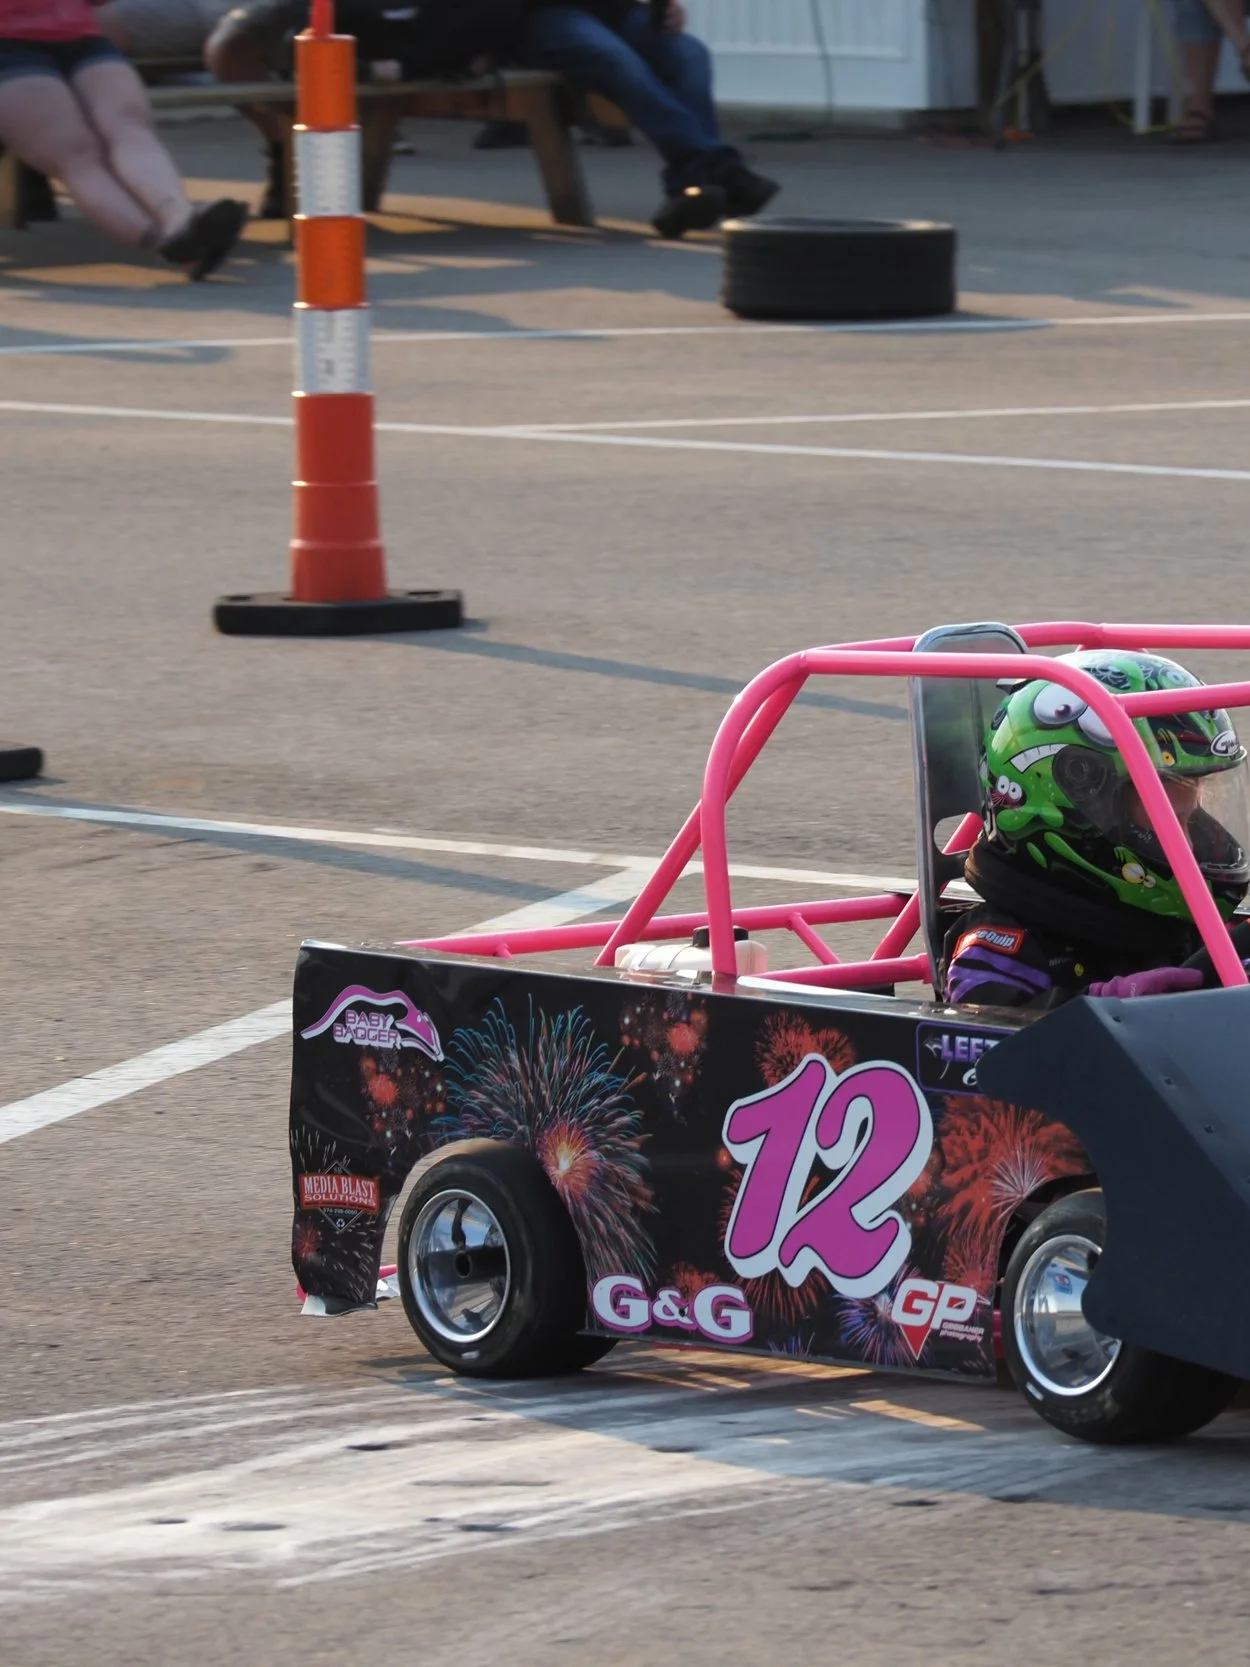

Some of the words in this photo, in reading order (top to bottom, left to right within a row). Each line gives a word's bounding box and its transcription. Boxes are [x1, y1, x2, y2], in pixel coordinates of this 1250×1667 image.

[966, 929, 1015, 949] eQuip
[345, 1010, 394, 1031] BABY
[333, 1023, 401, 1050] BADGER
[303, 1176, 339, 1194] MEDIA
[341, 1177, 375, 1199] BLAST
[722, 1052, 933, 1299] 12
[304, 1193, 376, 1207] SOLUTIONS
[592, 1273, 753, 1344] G&G
[891, 1278, 977, 1329] GP
